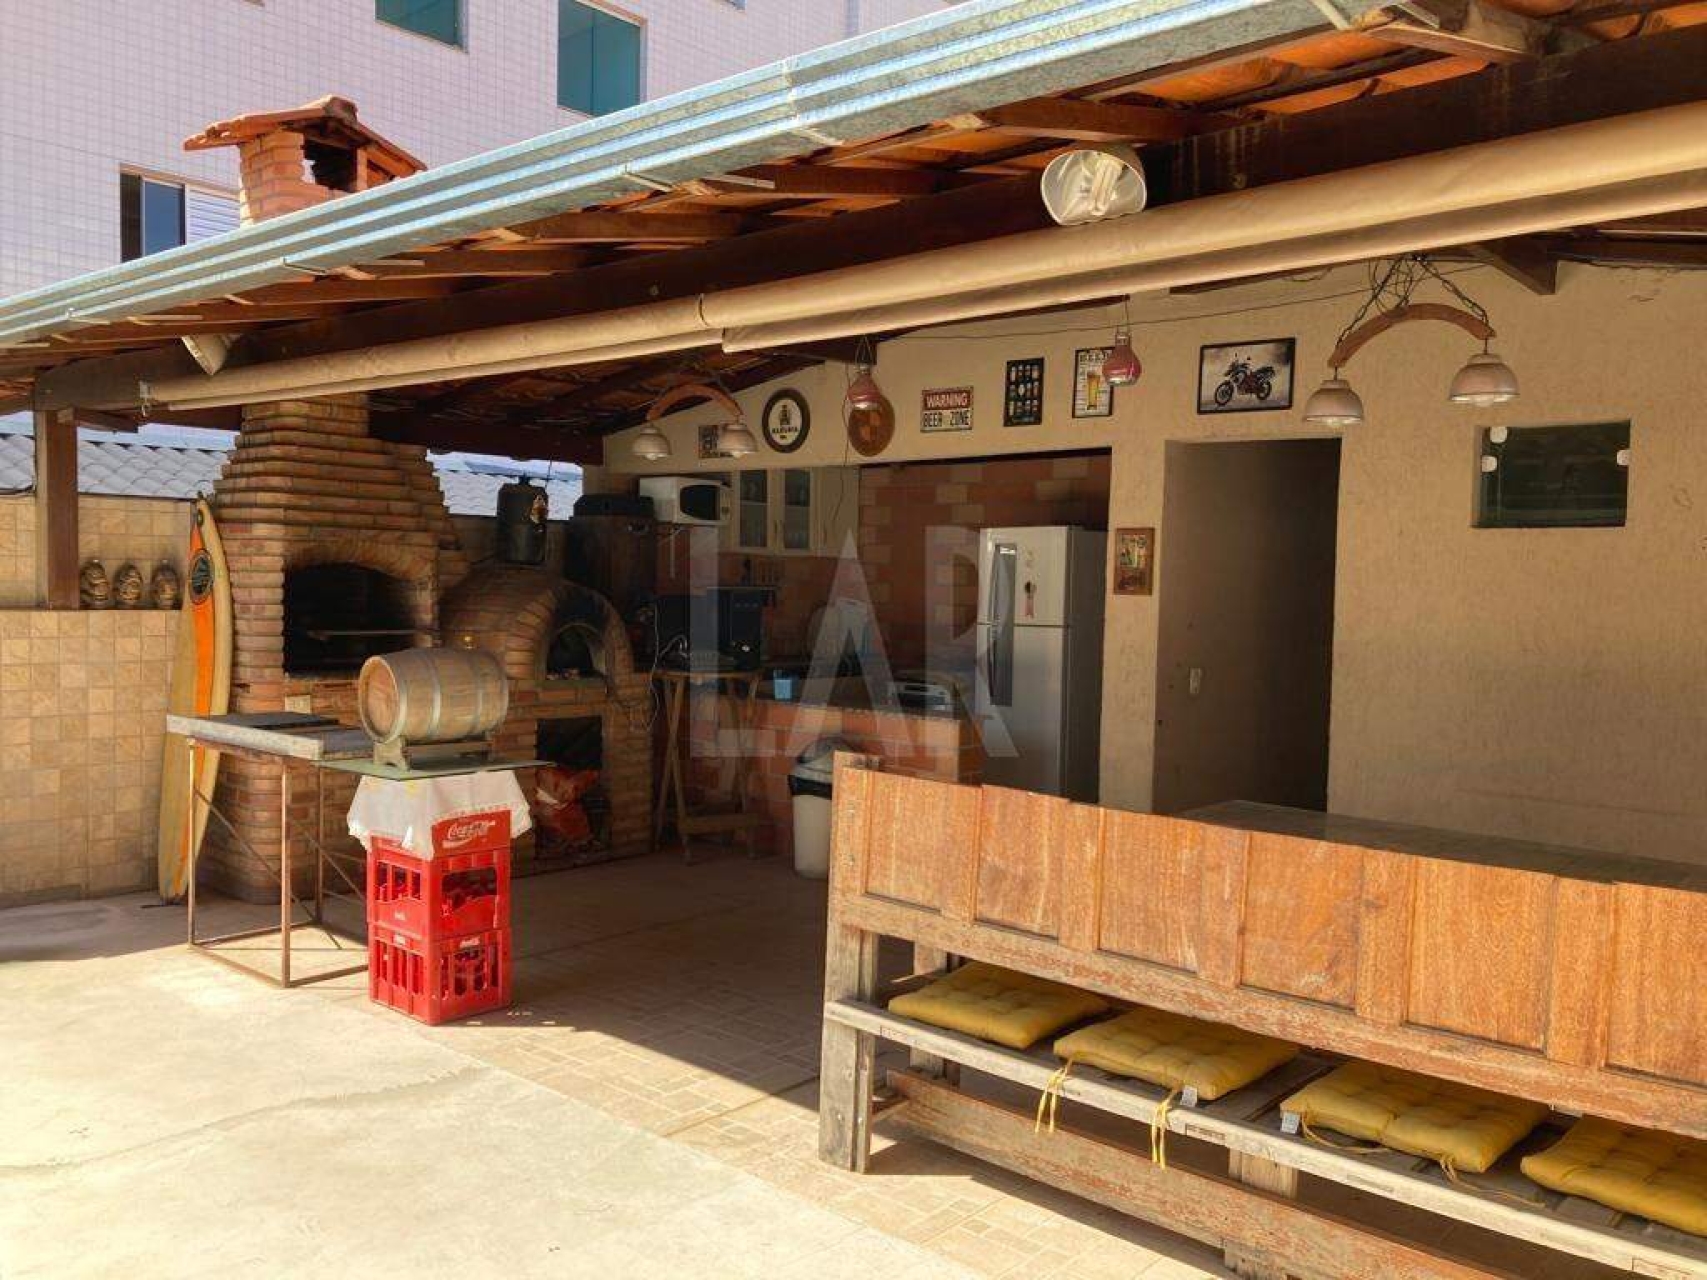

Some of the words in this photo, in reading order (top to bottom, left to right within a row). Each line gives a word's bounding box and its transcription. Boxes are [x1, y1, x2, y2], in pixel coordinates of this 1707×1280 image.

[925, 392, 968, 408] WARNING
[923, 411, 943, 428] BEER
[949, 409, 970, 427] ZONE
